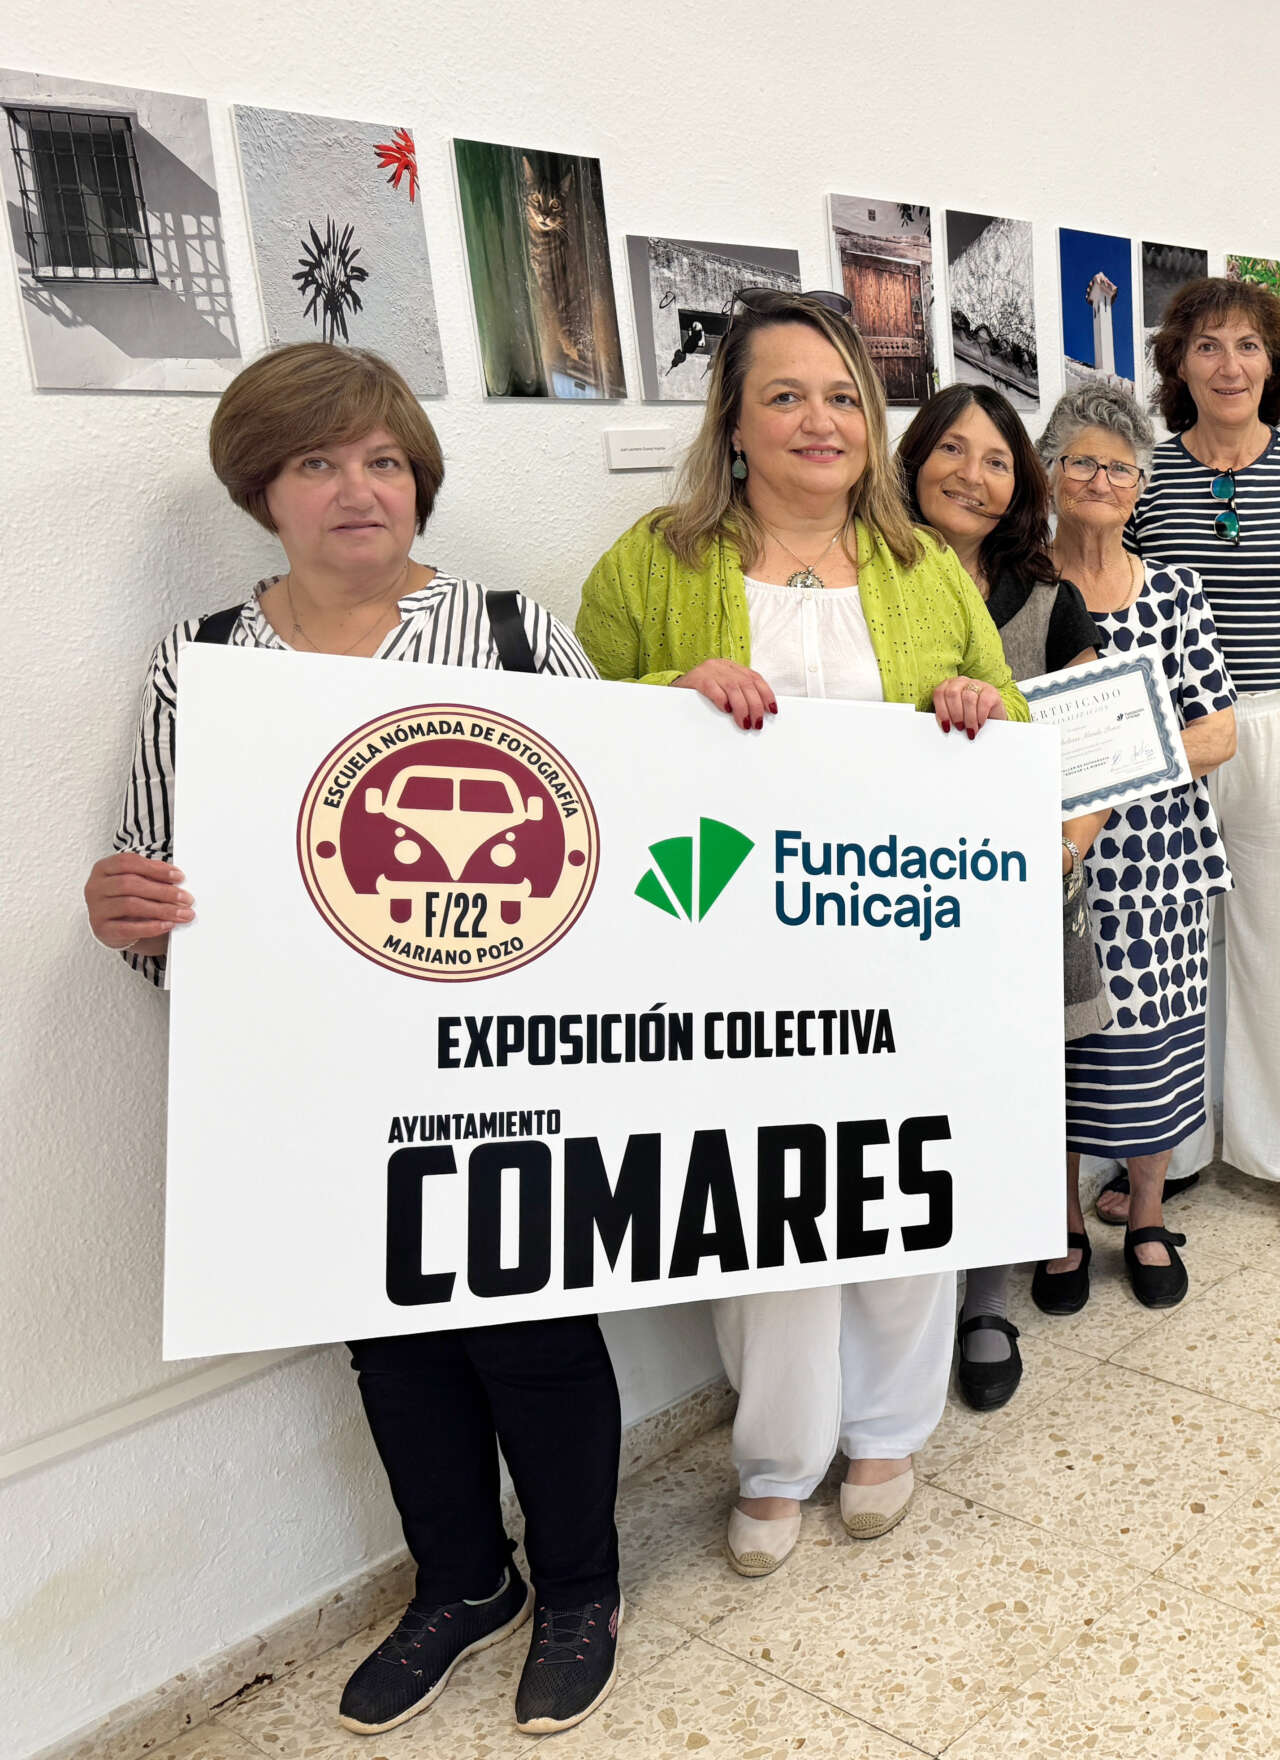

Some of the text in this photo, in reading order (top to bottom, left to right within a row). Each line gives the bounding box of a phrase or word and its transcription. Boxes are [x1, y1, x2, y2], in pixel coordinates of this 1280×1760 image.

[1030, 688, 1120, 722] ERTIFICADO
[323, 720, 579, 818] ESCUELA NÓMADA DE FOTOGRAFÍA
[775, 830, 1027, 882] Fundación
[425, 891, 488, 939] F/22
[775, 880, 961, 941] Unicaja
[383, 934, 525, 965] MARIANO POZO
[437, 1002, 896, 1069] EXPOSICIÓN COLECTIVA
[388, 1109, 561, 1144] AYUNTAMIENTO
[386, 1115, 953, 1307] COMARES
